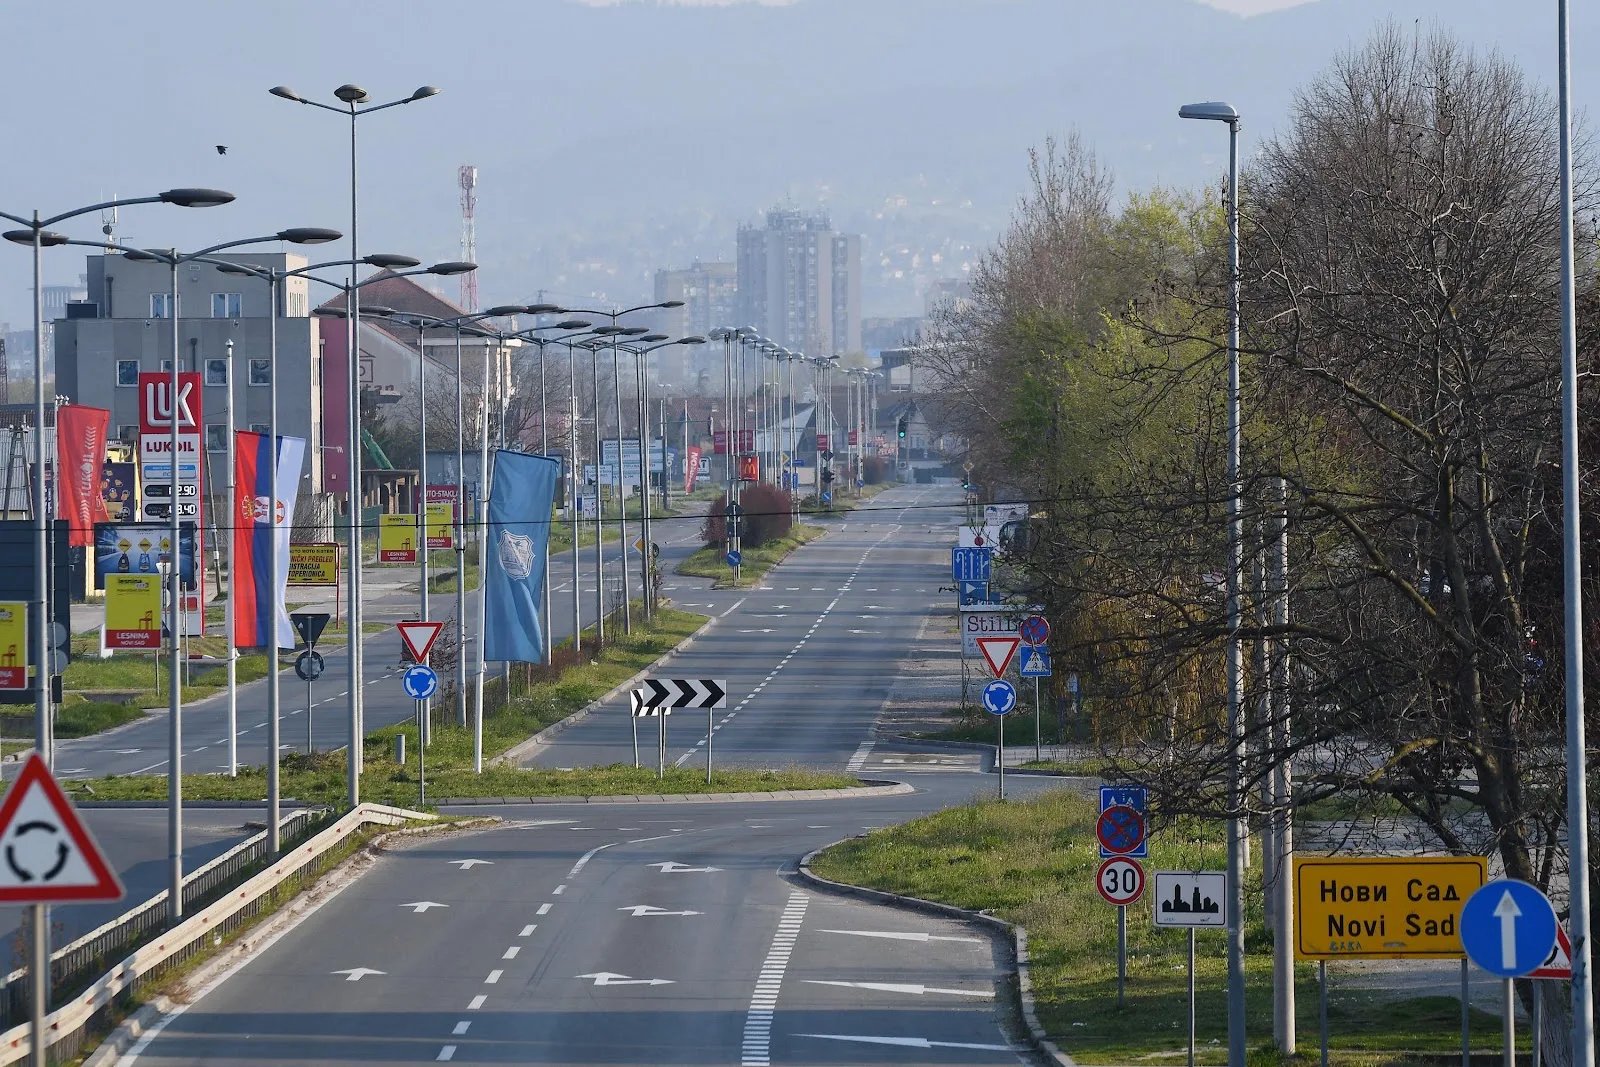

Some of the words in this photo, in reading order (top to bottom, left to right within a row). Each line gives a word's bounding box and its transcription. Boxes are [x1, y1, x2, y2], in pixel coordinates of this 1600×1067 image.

[168, 486, 196, 496] 12.90
[291, 554, 307, 562] NIČKI
[307, 555, 333, 563] PREGLED
[288, 570, 326, 578] TOPERIONICA
[1105, 868, 1136, 894] 30
[1320, 879, 1387, 903] Нови
[1406, 878, 1460, 902] Сад
[1328, 914, 1386, 937] Novi
[1405, 913, 1455, 937] Sad
